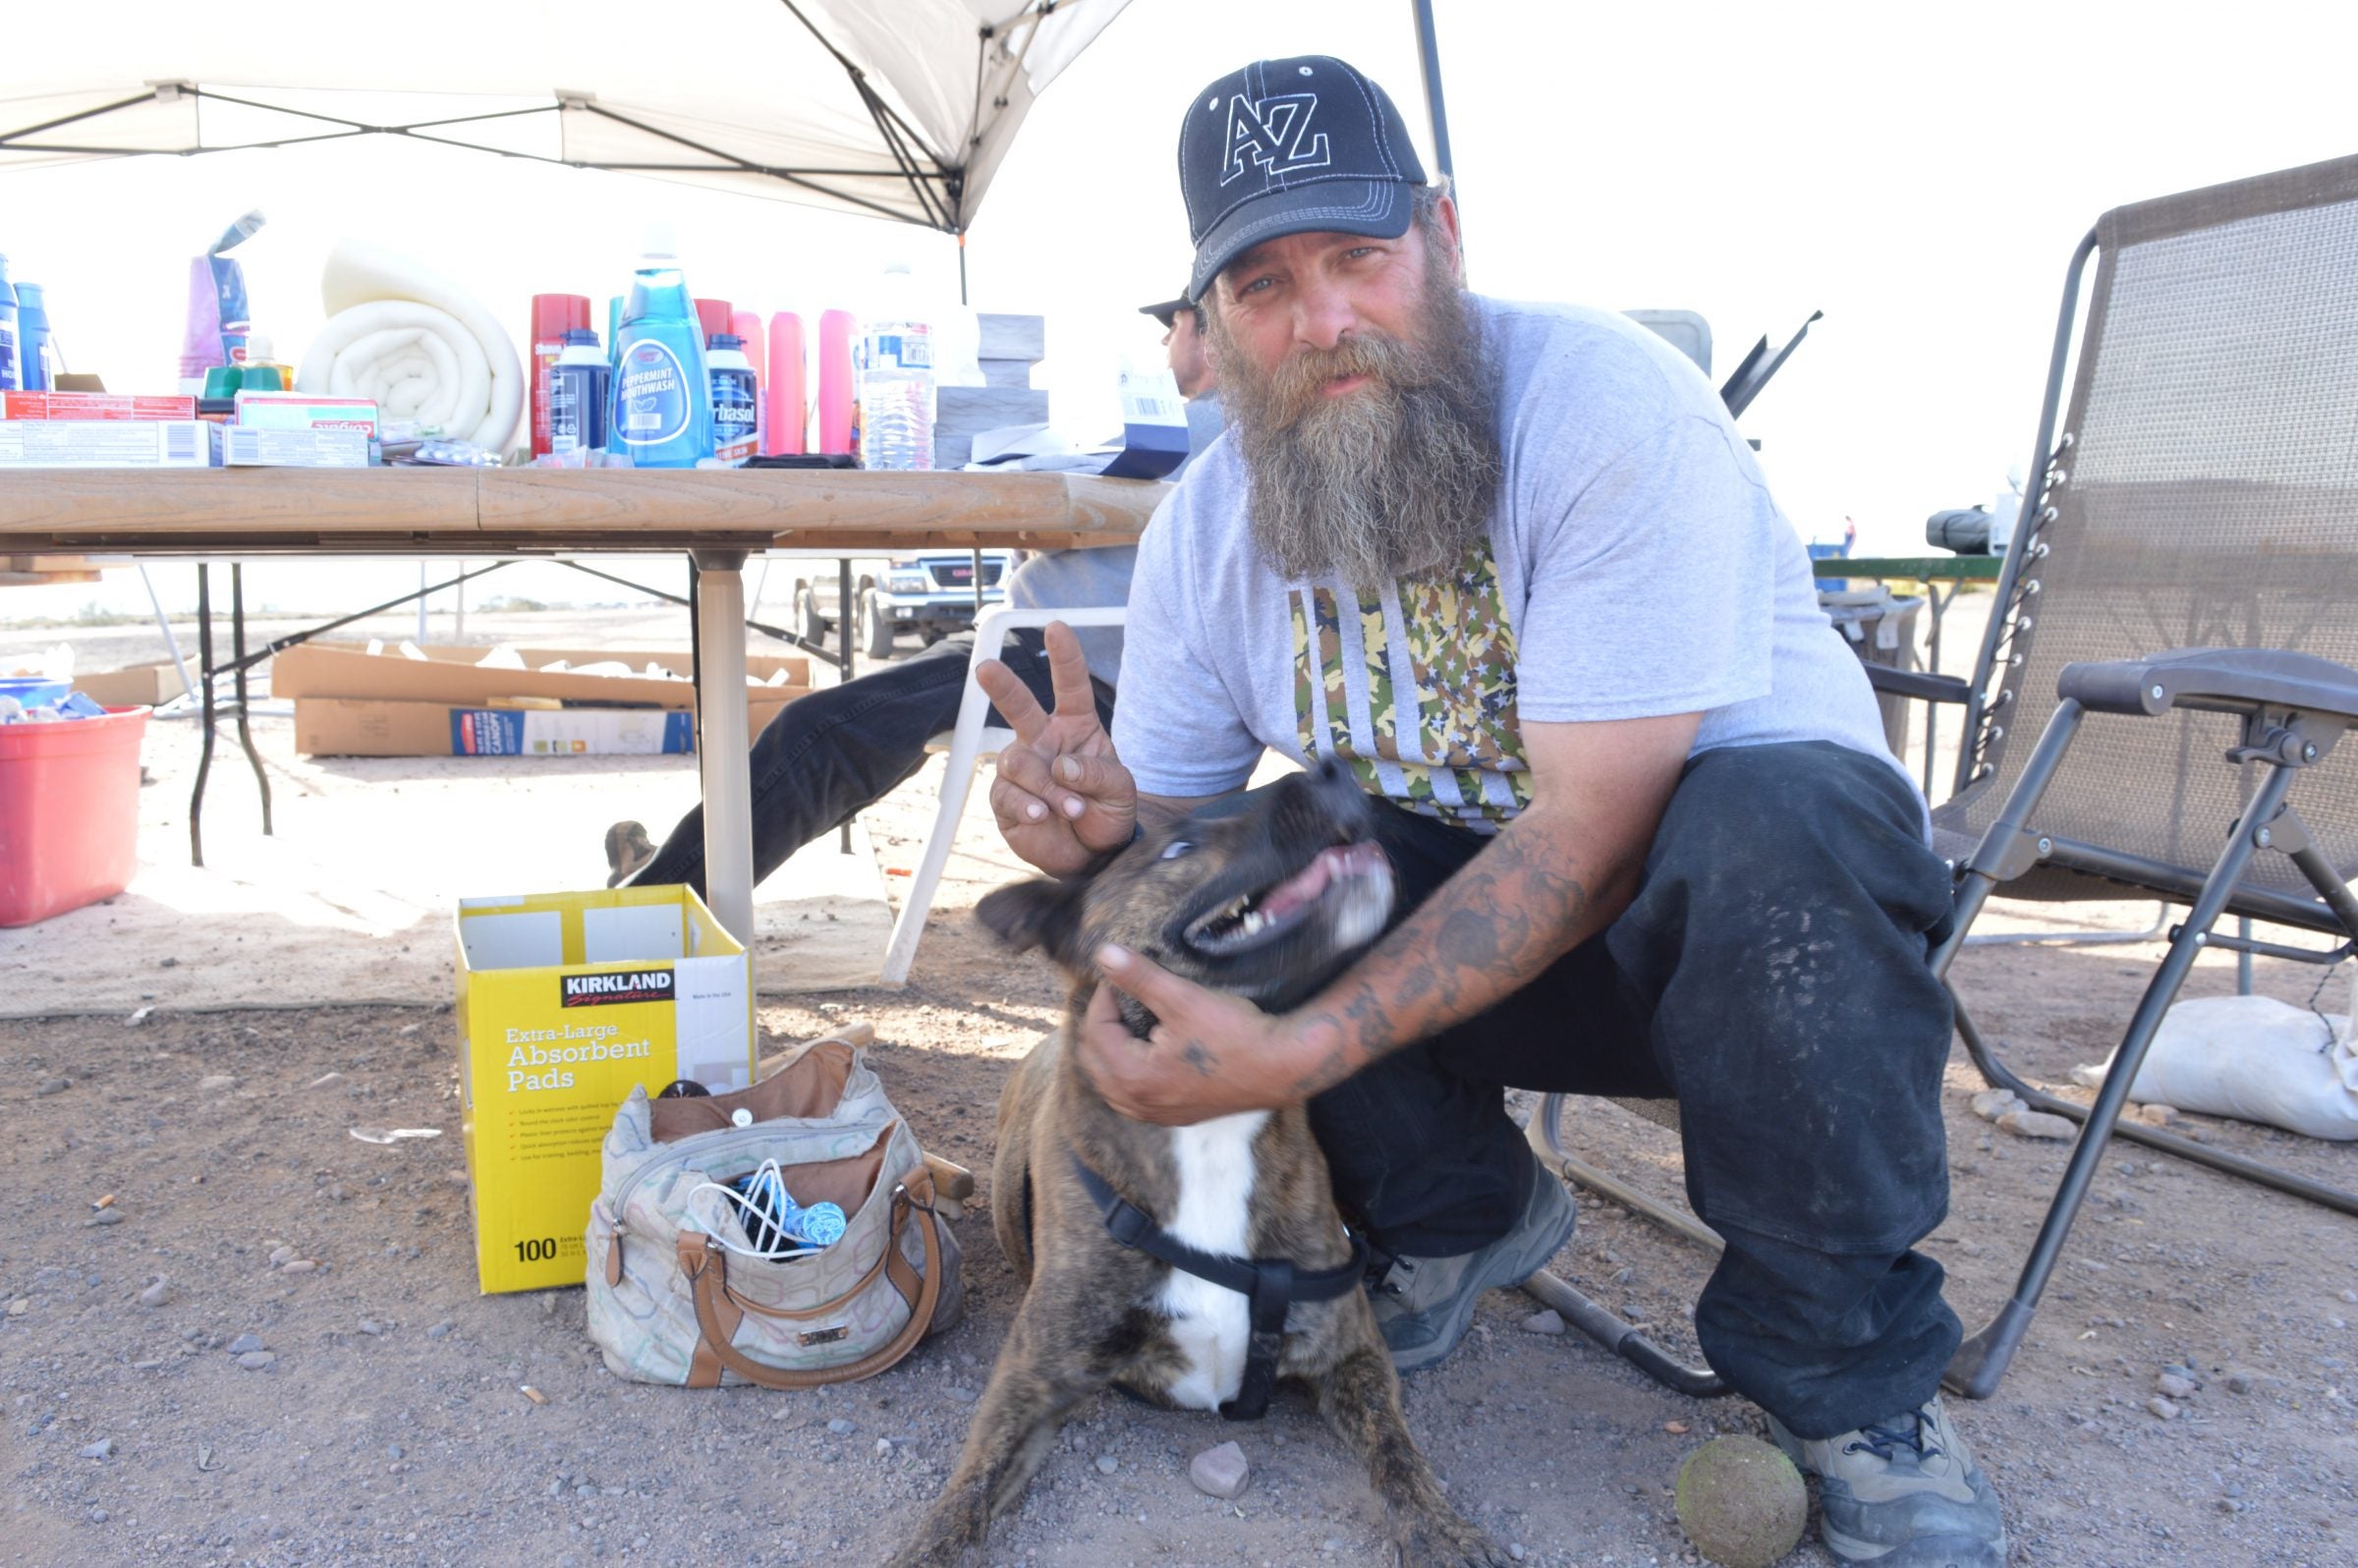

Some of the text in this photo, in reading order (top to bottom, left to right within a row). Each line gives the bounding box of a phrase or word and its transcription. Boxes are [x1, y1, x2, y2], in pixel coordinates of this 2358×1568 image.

[1220, 92, 1330, 187] AZ
[620, 378, 675, 402] MOUTHWASH
[622, 367, 672, 389] PEPPERMINT
[712, 403, 756, 422] rbasol
[489, 712, 502, 755] CANOPY
[567, 973, 671, 994] KIRKLAND
[567, 990, 671, 1007] Signature
[505, 1024, 618, 1044] Extra-Large
[507, 1039, 650, 1067] Absorbent
[507, 1068, 575, 1092] Pads
[514, 1237, 557, 1262] 100
